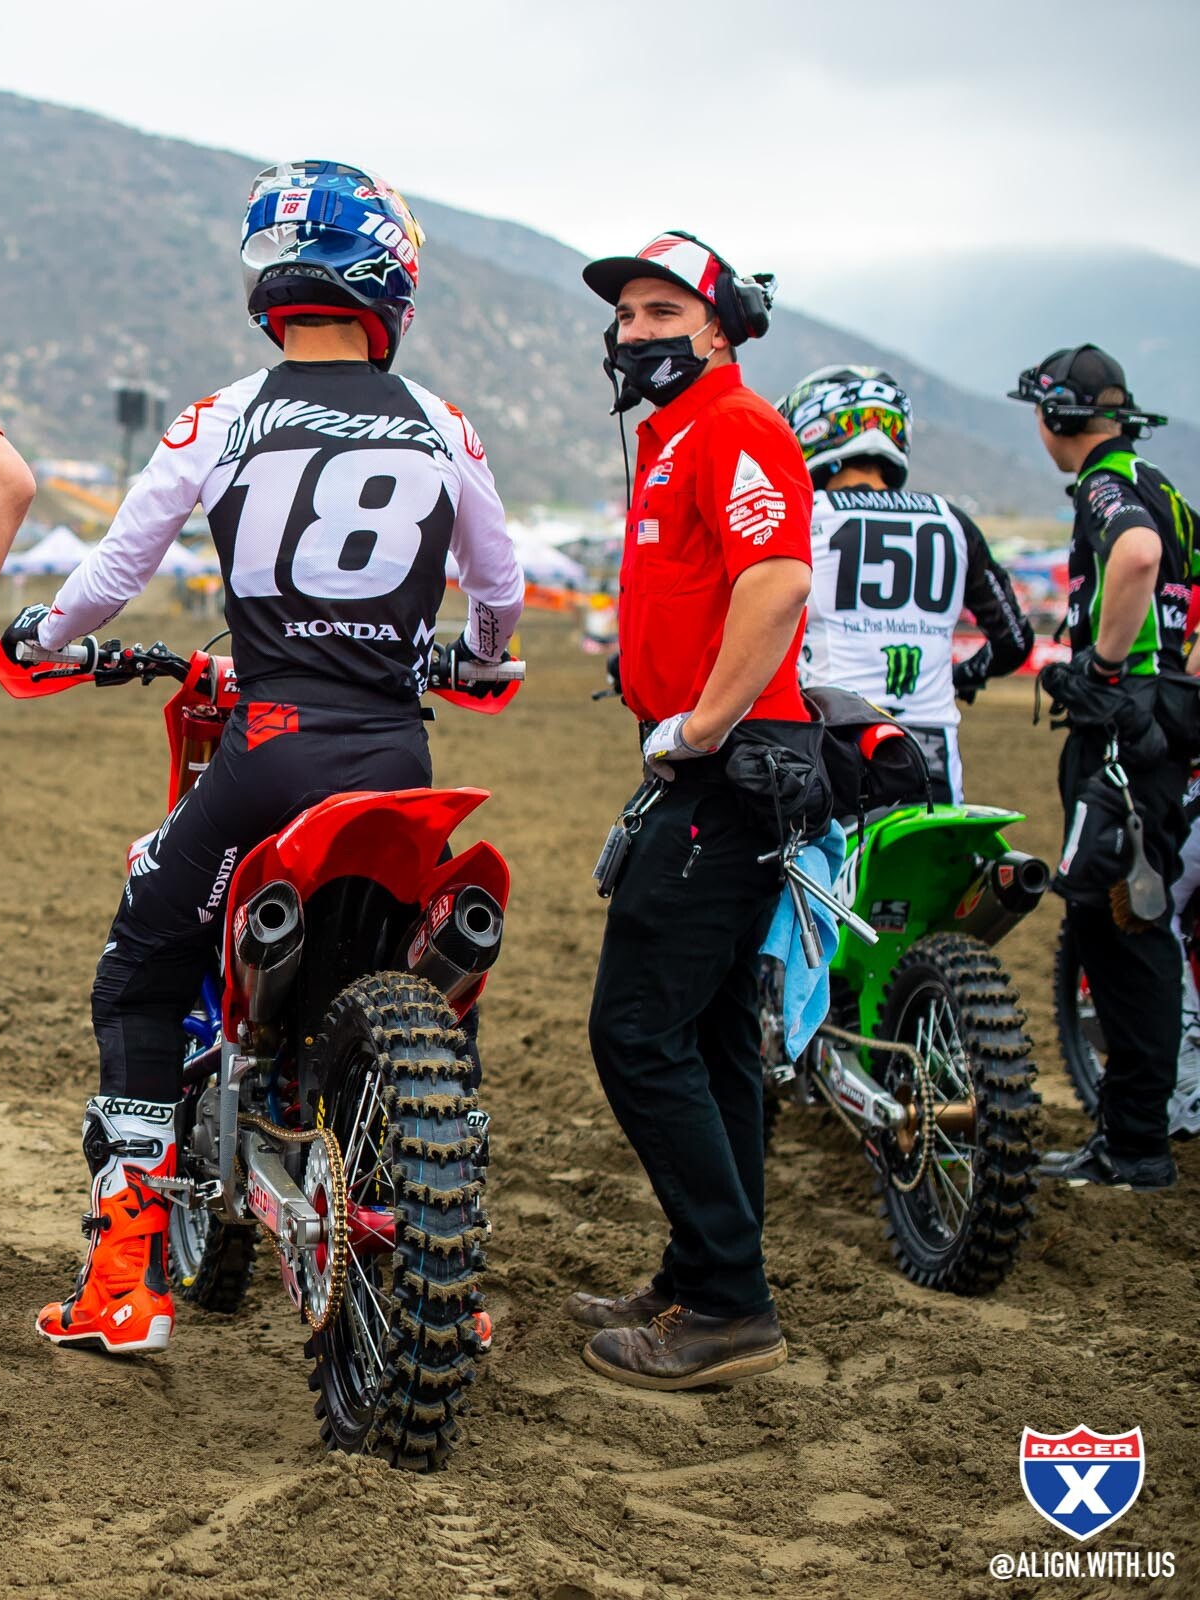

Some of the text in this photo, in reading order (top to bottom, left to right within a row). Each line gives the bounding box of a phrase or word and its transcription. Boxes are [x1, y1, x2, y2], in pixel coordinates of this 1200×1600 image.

[282, 203, 299, 214] 18
[357, 211, 417, 265] 100
[655, 371, 683, 388] HONDA
[215, 399, 454, 468] LAWRENCE
[831, 491, 939, 513] HAMMAKER
[229, 447, 444, 600] 18
[829, 518, 958, 613] 150
[282, 619, 401, 642] HONDA
[206, 846, 238, 908] HONDA
[102, 1097, 173, 1125] Astars
